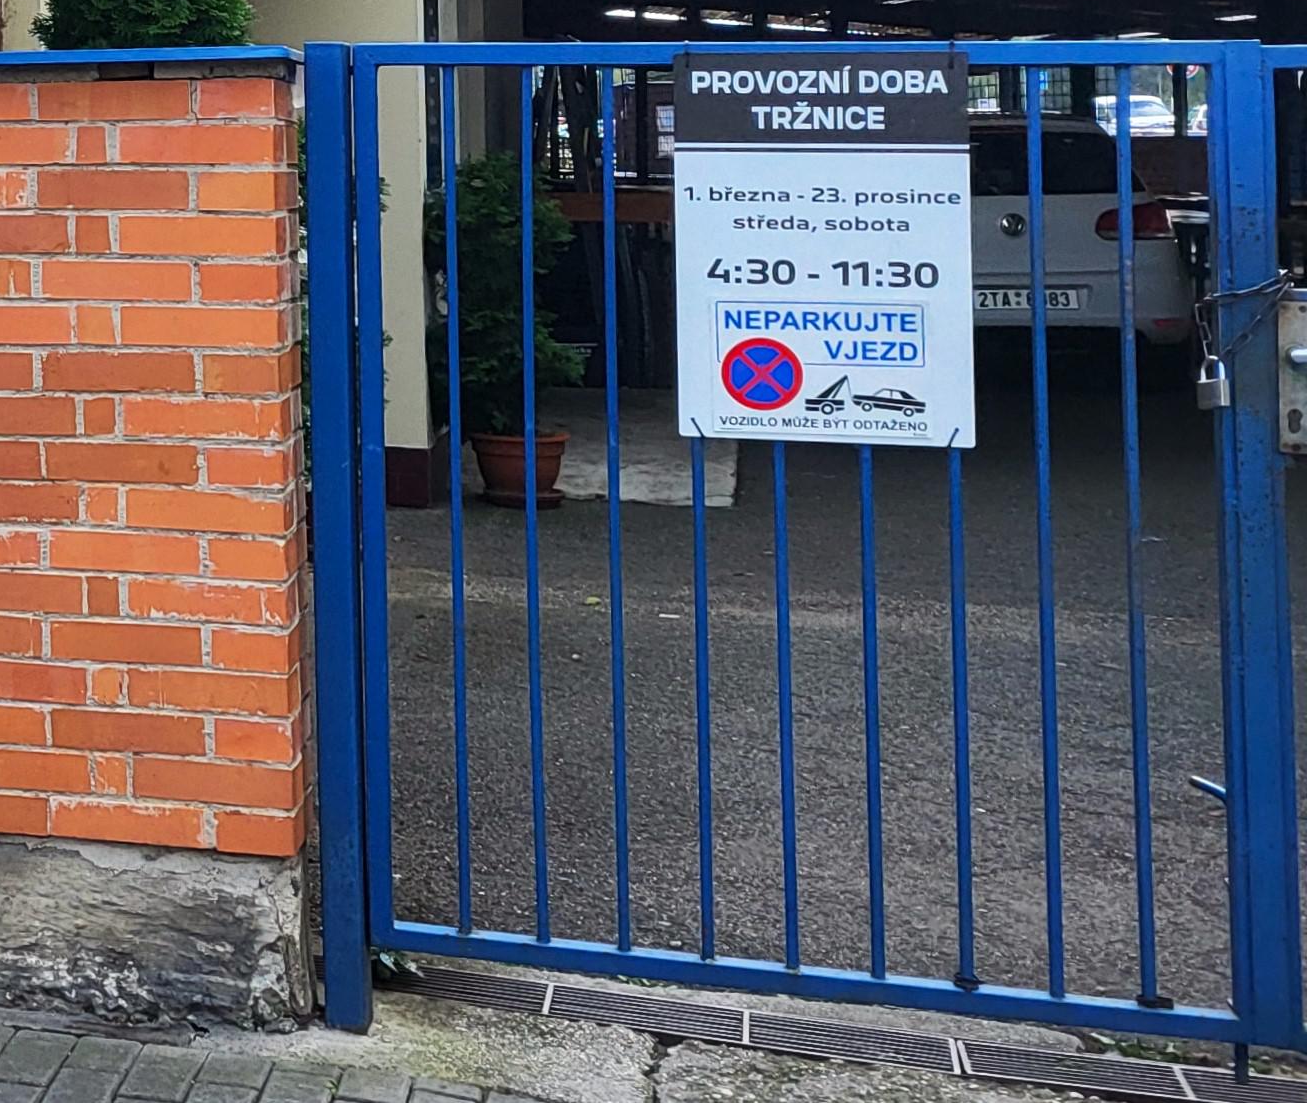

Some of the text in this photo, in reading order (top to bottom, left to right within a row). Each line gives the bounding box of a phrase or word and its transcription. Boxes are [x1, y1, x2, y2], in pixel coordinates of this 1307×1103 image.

[691, 65, 948, 95] PROVOZNÍ DOBA
[751, 101, 886, 131] TRŽNICE
[684, 186, 702, 202] 1.
[709, 185, 791, 204] března
[811, 187, 847, 205] 23.
[855, 187, 962, 209] prosince
[732, 215, 911, 234] středa, sobota
[706, 257, 797, 286] 4:30
[832, 260, 940, 289] 11:30
[724, 309, 918, 333] NEPARKUJTE
[824, 339, 919, 363] VJEZD
[719, 415, 778, 428] VOZIDLO
[822, 417, 849, 430] BÝT
[853, 418, 928, 433] ODTAŽENO
